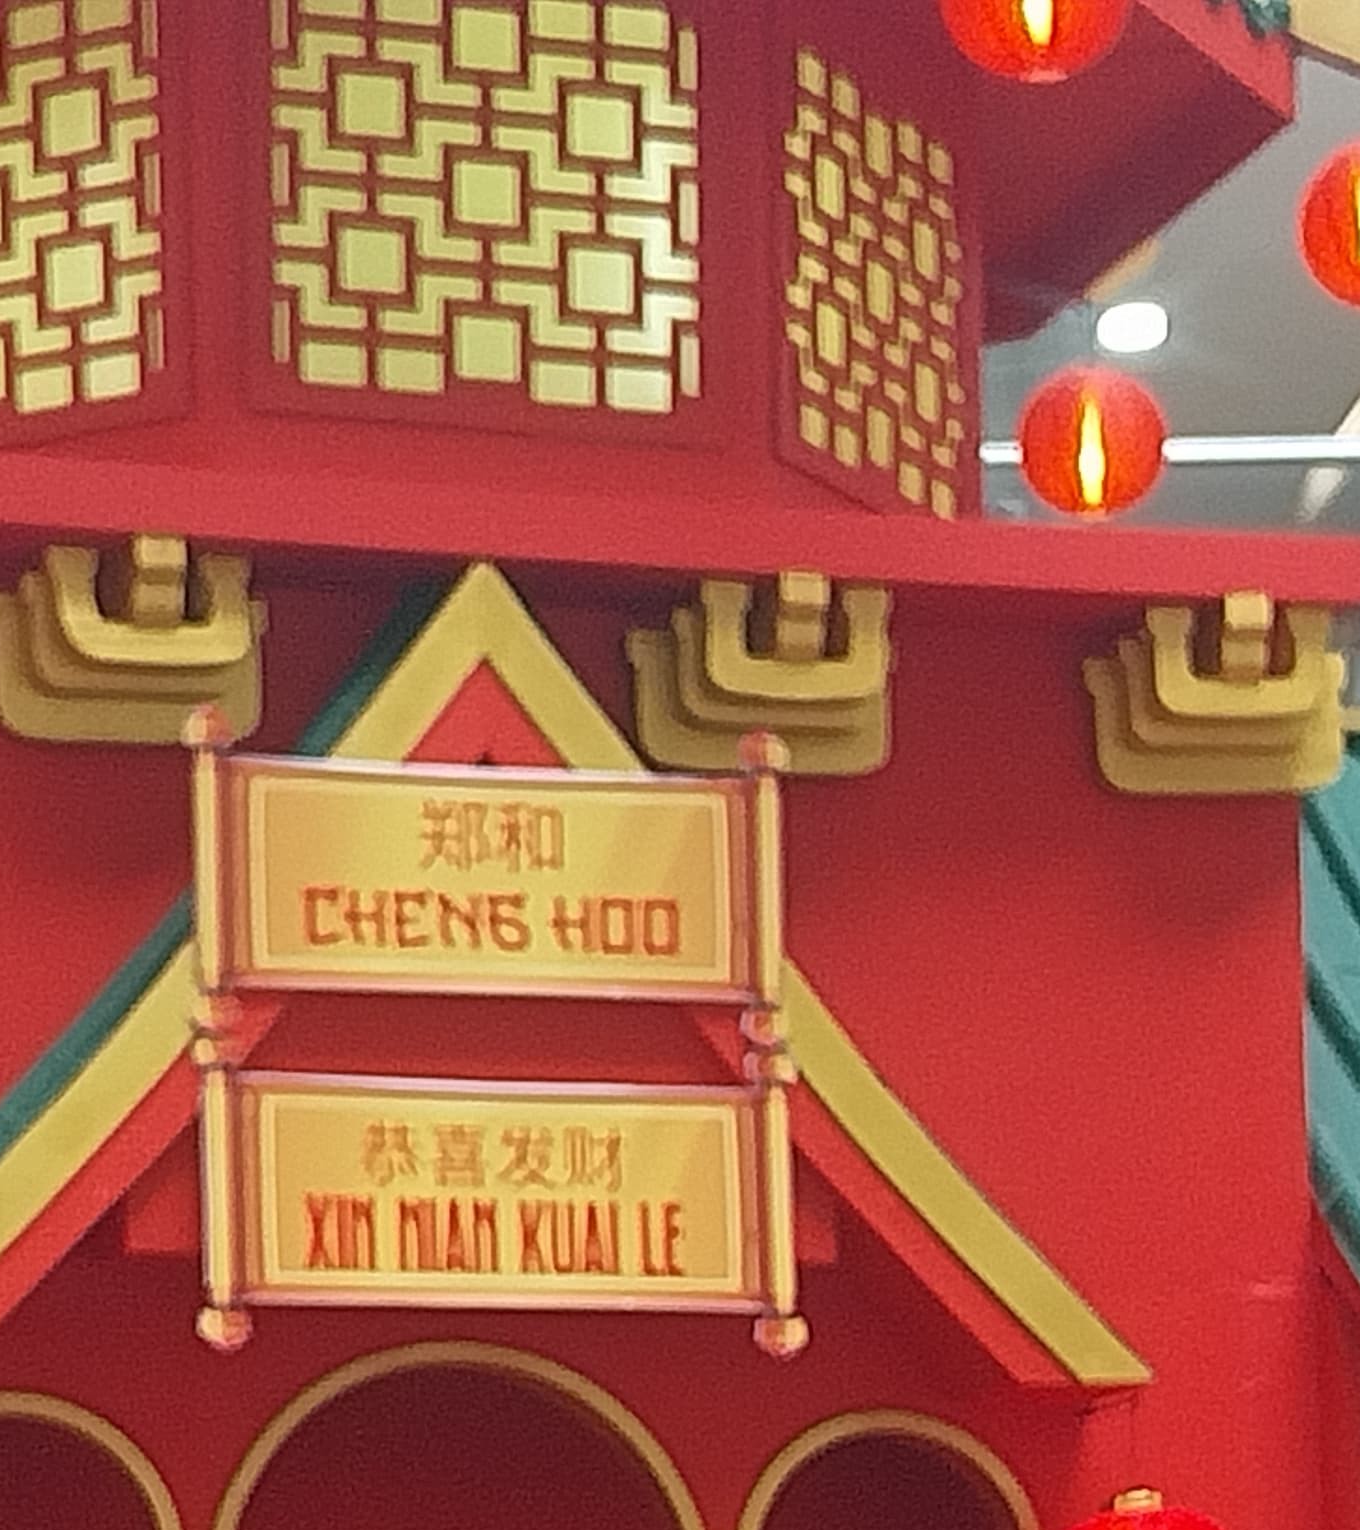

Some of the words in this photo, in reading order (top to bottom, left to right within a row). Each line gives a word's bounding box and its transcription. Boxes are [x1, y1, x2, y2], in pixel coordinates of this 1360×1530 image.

[419, 799, 565, 873] 郑和
[303, 886, 531, 953] CHENG
[551, 894, 681, 956] HOO
[360, 1119, 624, 1193] 恭喜发财
[304, 1193, 376, 1272] XIN
[398, 1197, 498, 1273] NIAN
[518, 1199, 619, 1275] KUAI
[639, 1201, 686, 1277] LE
